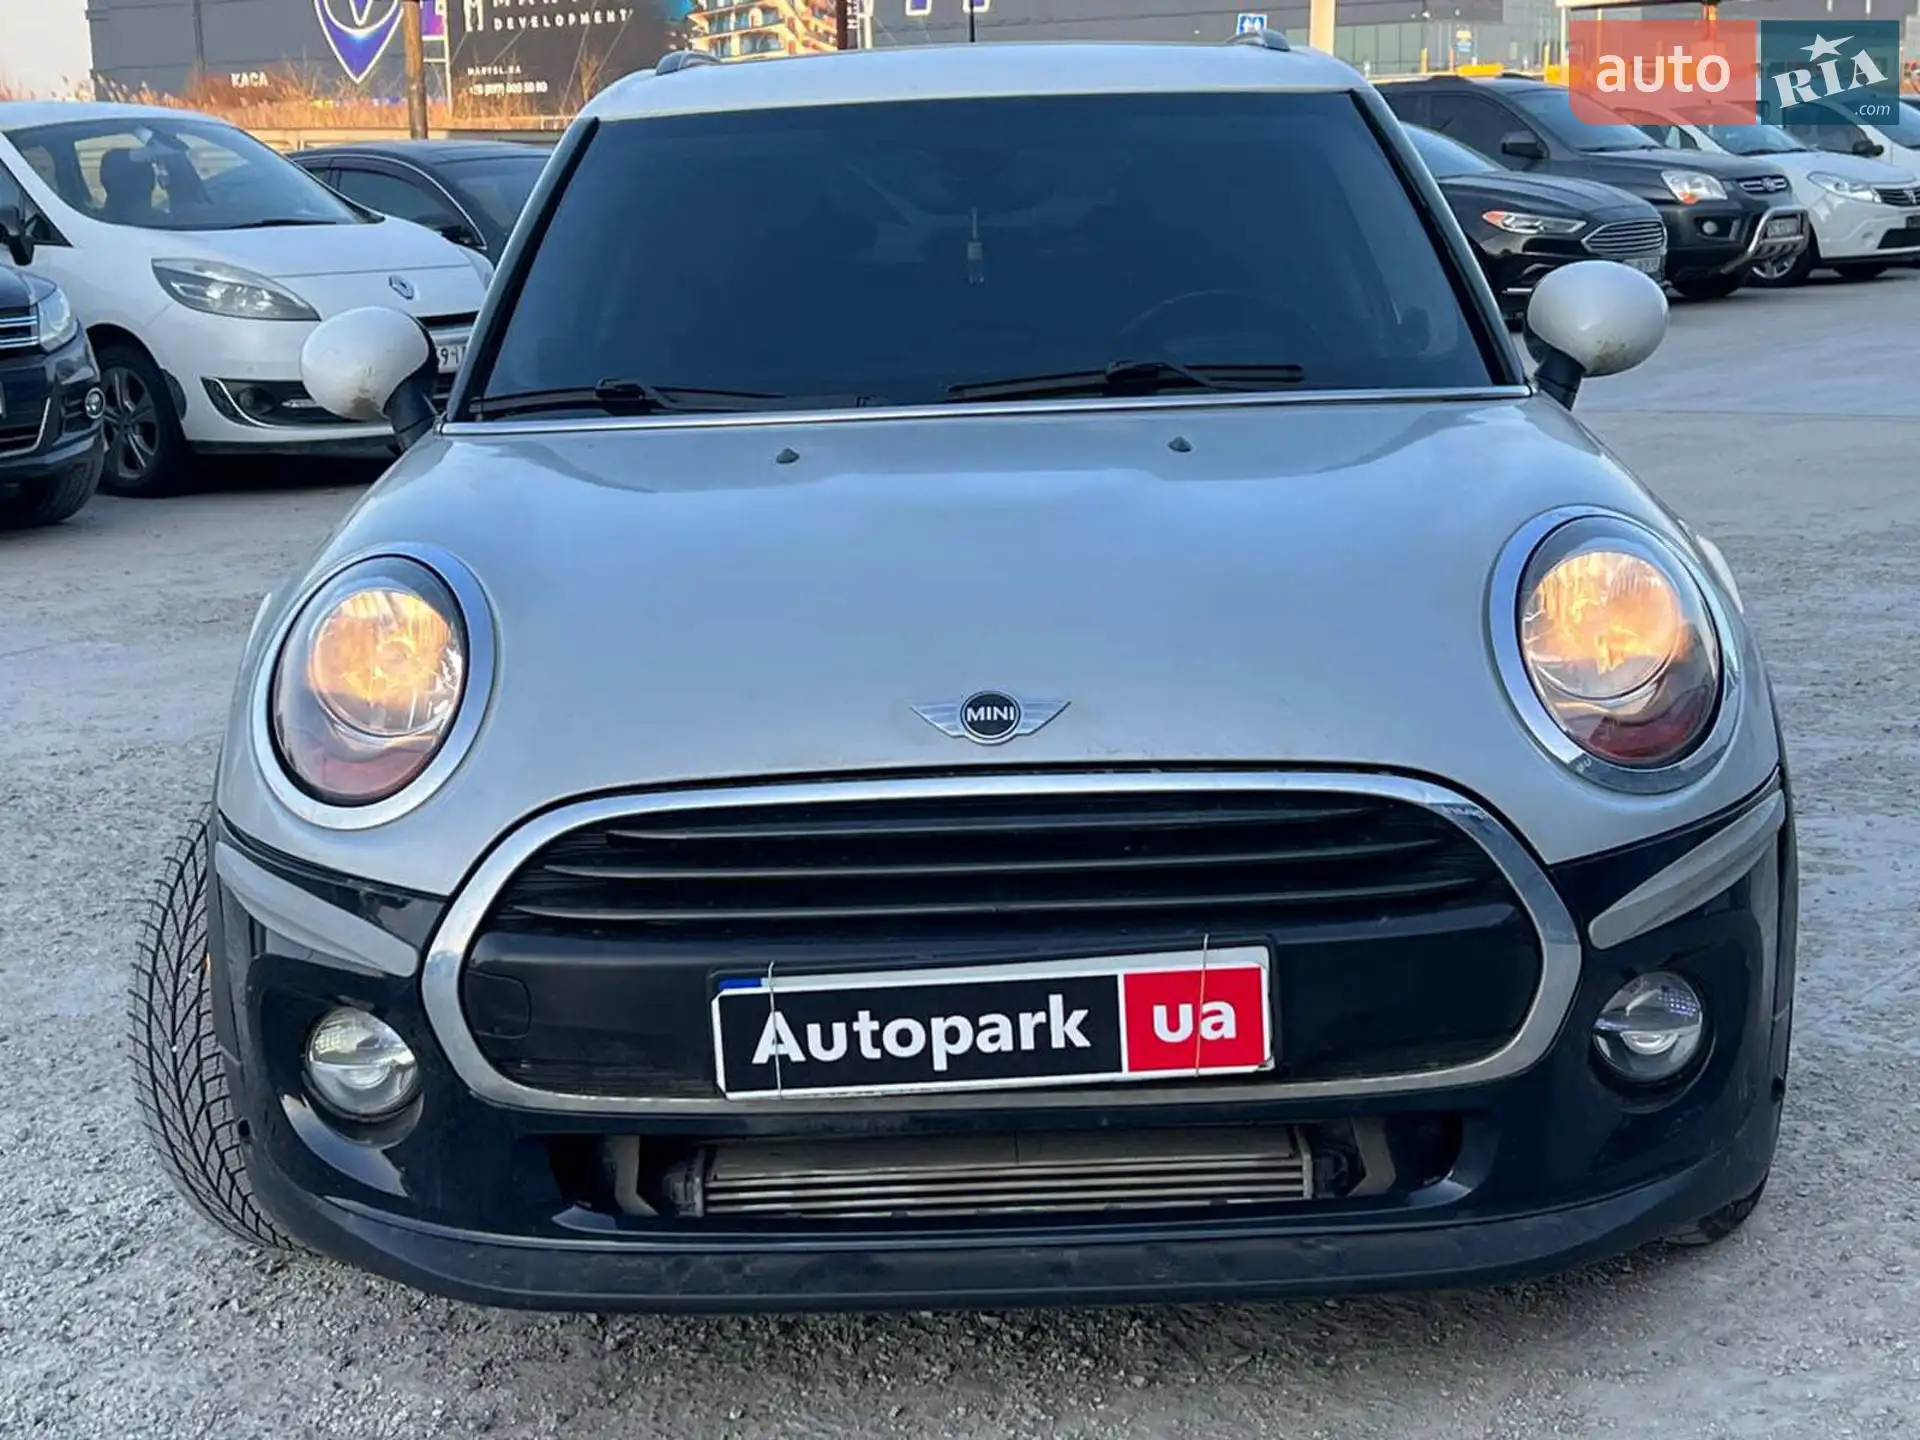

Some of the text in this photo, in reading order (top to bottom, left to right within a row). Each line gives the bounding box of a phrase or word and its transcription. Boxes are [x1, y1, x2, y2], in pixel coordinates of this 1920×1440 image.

[493, 8, 628, 31] DEVELOPMENT
[967, 706, 1015, 723] MINI
[751, 994, 1236, 1071] Autopark ua
